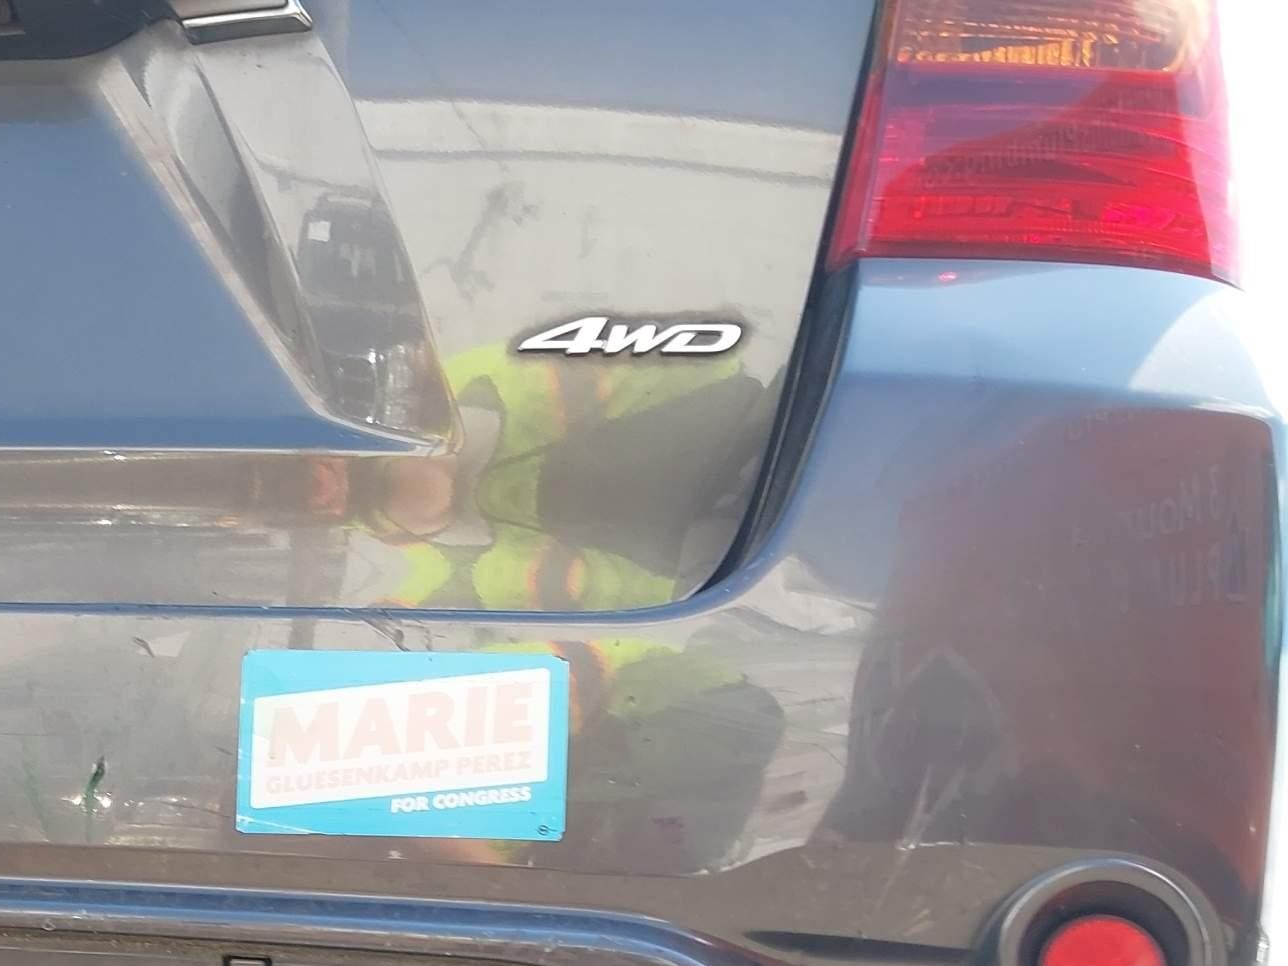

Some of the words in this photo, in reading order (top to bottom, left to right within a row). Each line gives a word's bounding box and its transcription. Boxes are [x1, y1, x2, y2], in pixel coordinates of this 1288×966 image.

[517, 316, 742, 354] 4WD
[267, 683, 533, 768] MARIE
[266, 760, 449, 794] GLUESENKAMP
[455, 751, 533, 776] PEREZ
[390, 798, 430, 814] FOR
[433, 787, 532, 811] CONGRESS
